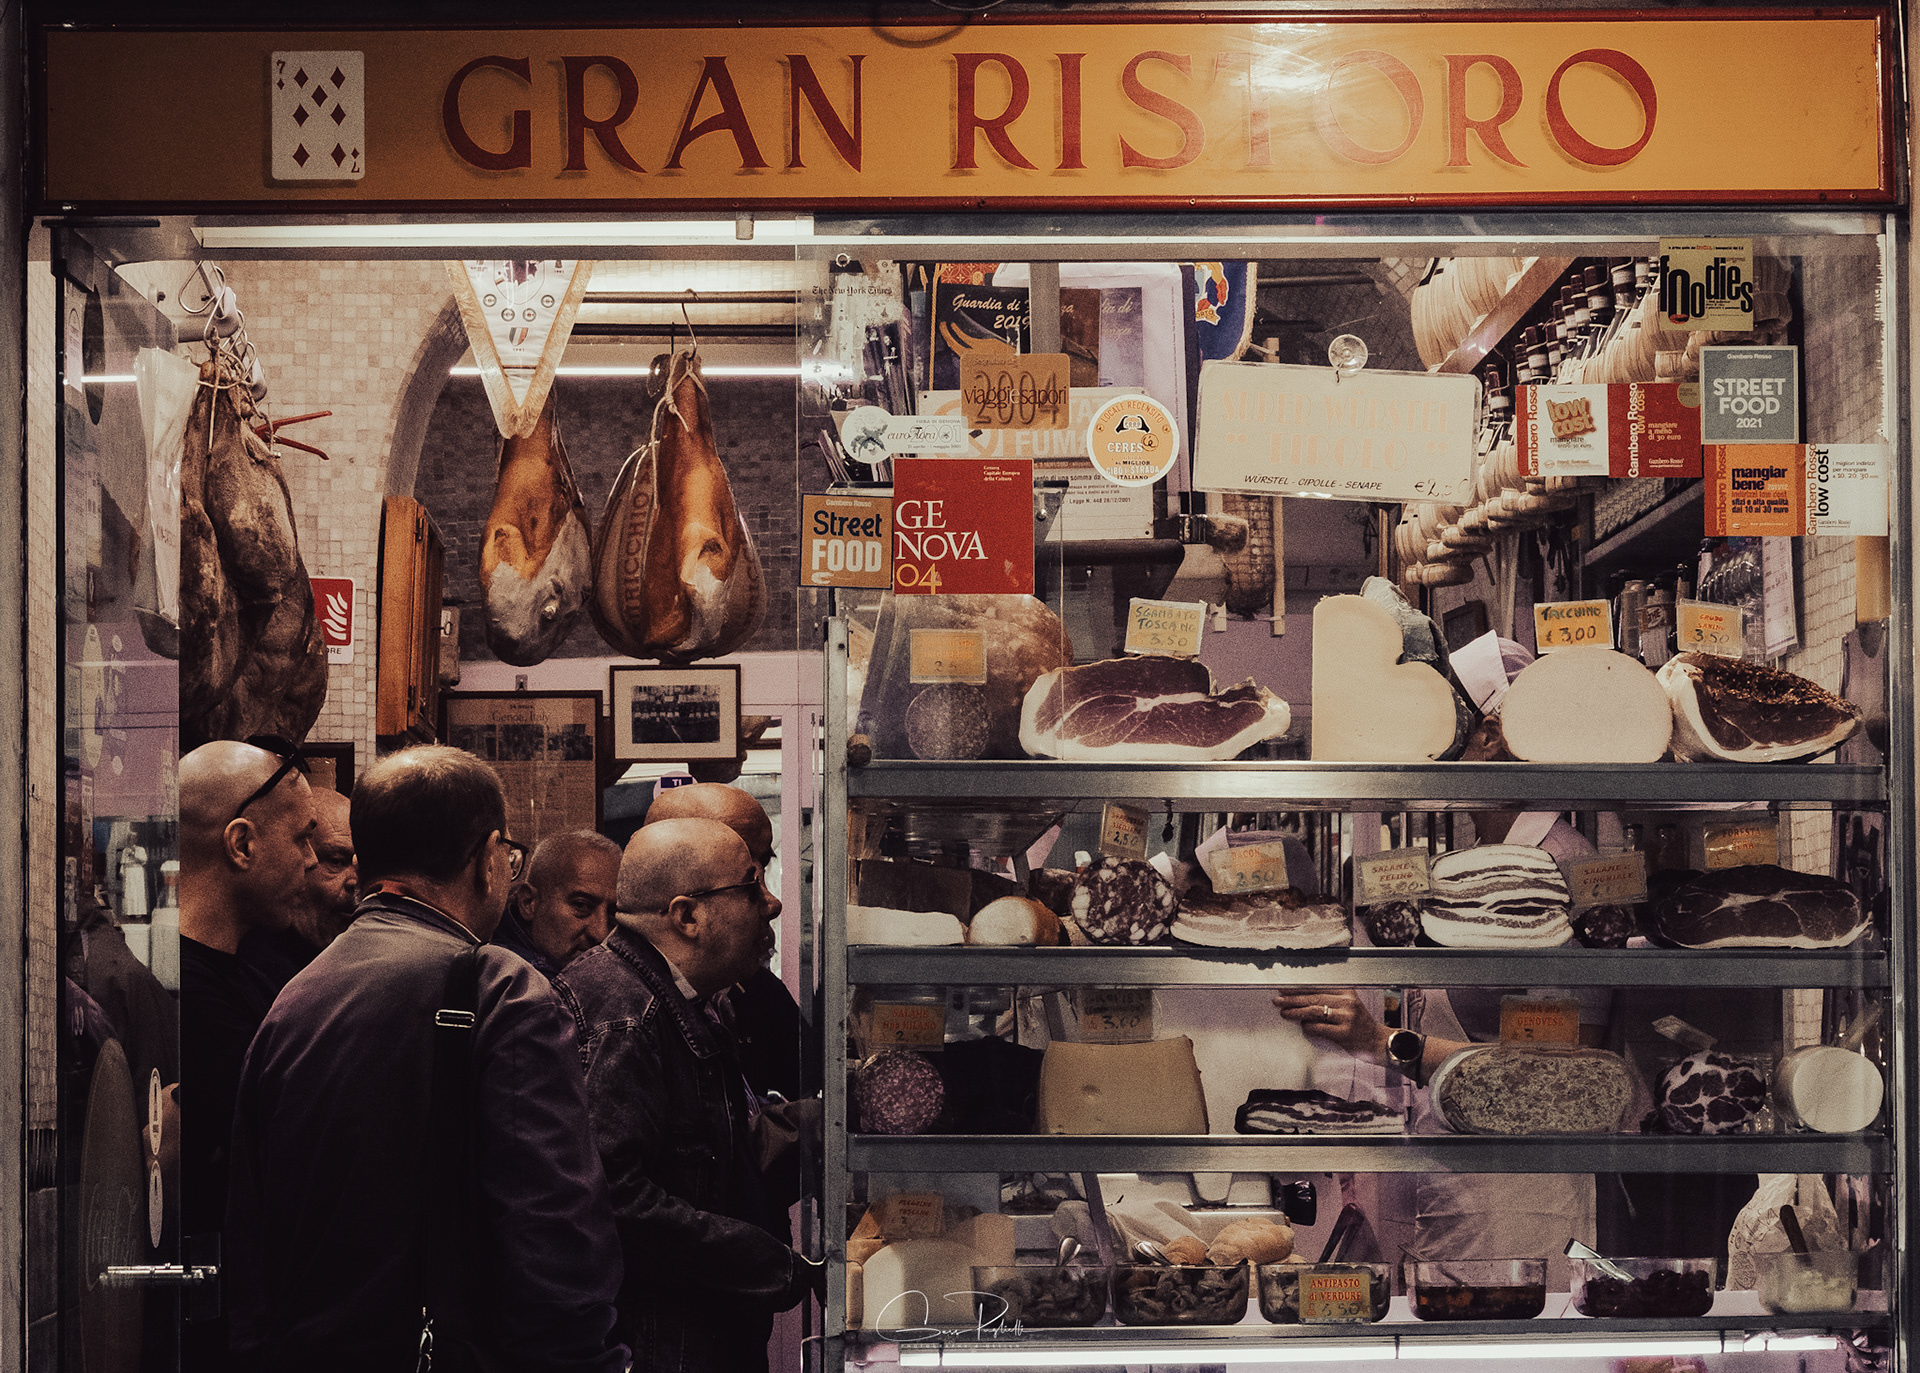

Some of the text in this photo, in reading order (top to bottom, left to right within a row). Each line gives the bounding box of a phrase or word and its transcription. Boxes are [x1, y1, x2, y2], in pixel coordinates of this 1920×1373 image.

[441, 48, 1659, 175] GRAN RISTORO
[812, 286, 893, 296] The New York Times
[1660, 255, 1753, 324] foodies
[952, 293, 1021, 312] Guardia di
[1196, 309, 1214, 319] ORTO
[1712, 378, 1787, 396] STREET
[975, 370, 1060, 425] 2004
[1719, 396, 1780, 415] FOOD
[1101, 402, 1125, 423] LOCALE
[1127, 401, 1164, 423] RECENSITO
[1221, 388, 1454, 435] SUPER WÜRSTEL
[1546, 397, 1590, 422] low
[1637, 389, 1646, 434] low cost
[1528, 384, 1539, 476] Gambero Rosso
[1552, 413, 1594, 437] cost
[1627, 383, 1639, 478] Gambero Rosso
[1648, 422, 1678, 430] mangiare
[1736, 417, 1762, 428] 2021
[1107, 442, 1143, 453] CERES
[1266, 431, 1408, 471] TIROLO
[1106, 465, 1160, 475] CIBO STRADA
[1731, 465, 1788, 480] mangiar
[1244, 473, 1382, 491] WÜRSTEL CIPOLLE SENAPE
[1731, 477, 1764, 490] bene
[1807, 443, 1817, 536] Gambero Rosso
[1814, 449, 1829, 516] low cost
[825, 499, 872, 508] Gambero Rosso
[895, 500, 947, 529] GE
[813, 510, 882, 537] Street
[894, 530, 988, 561] NOVA
[812, 539, 882, 572] FOOD
[896, 563, 943, 595] 04
[1136, 606, 1197, 620] SGAMBATO
[1541, 606, 1601, 621] TACCHINO
[1699, 614, 1724, 622] CRUDO
[1137, 618, 1196, 632] TOSCANO
[1231, 848, 1260, 860] BACON
[1372, 863, 1410, 873] SALAME
[1584, 864, 1621, 876] SALAME
[1379, 872, 1413, 882] FELINO
[892, 1009, 928, 1018] SALAME
[1517, 1016, 1564, 1026] GENOVESE
[903, 1021, 936, 1030] MILANO
[1310, 1278, 1360, 1288] ANTIPASTO
[1309, 1291, 1361, 1301] di VERDURE
